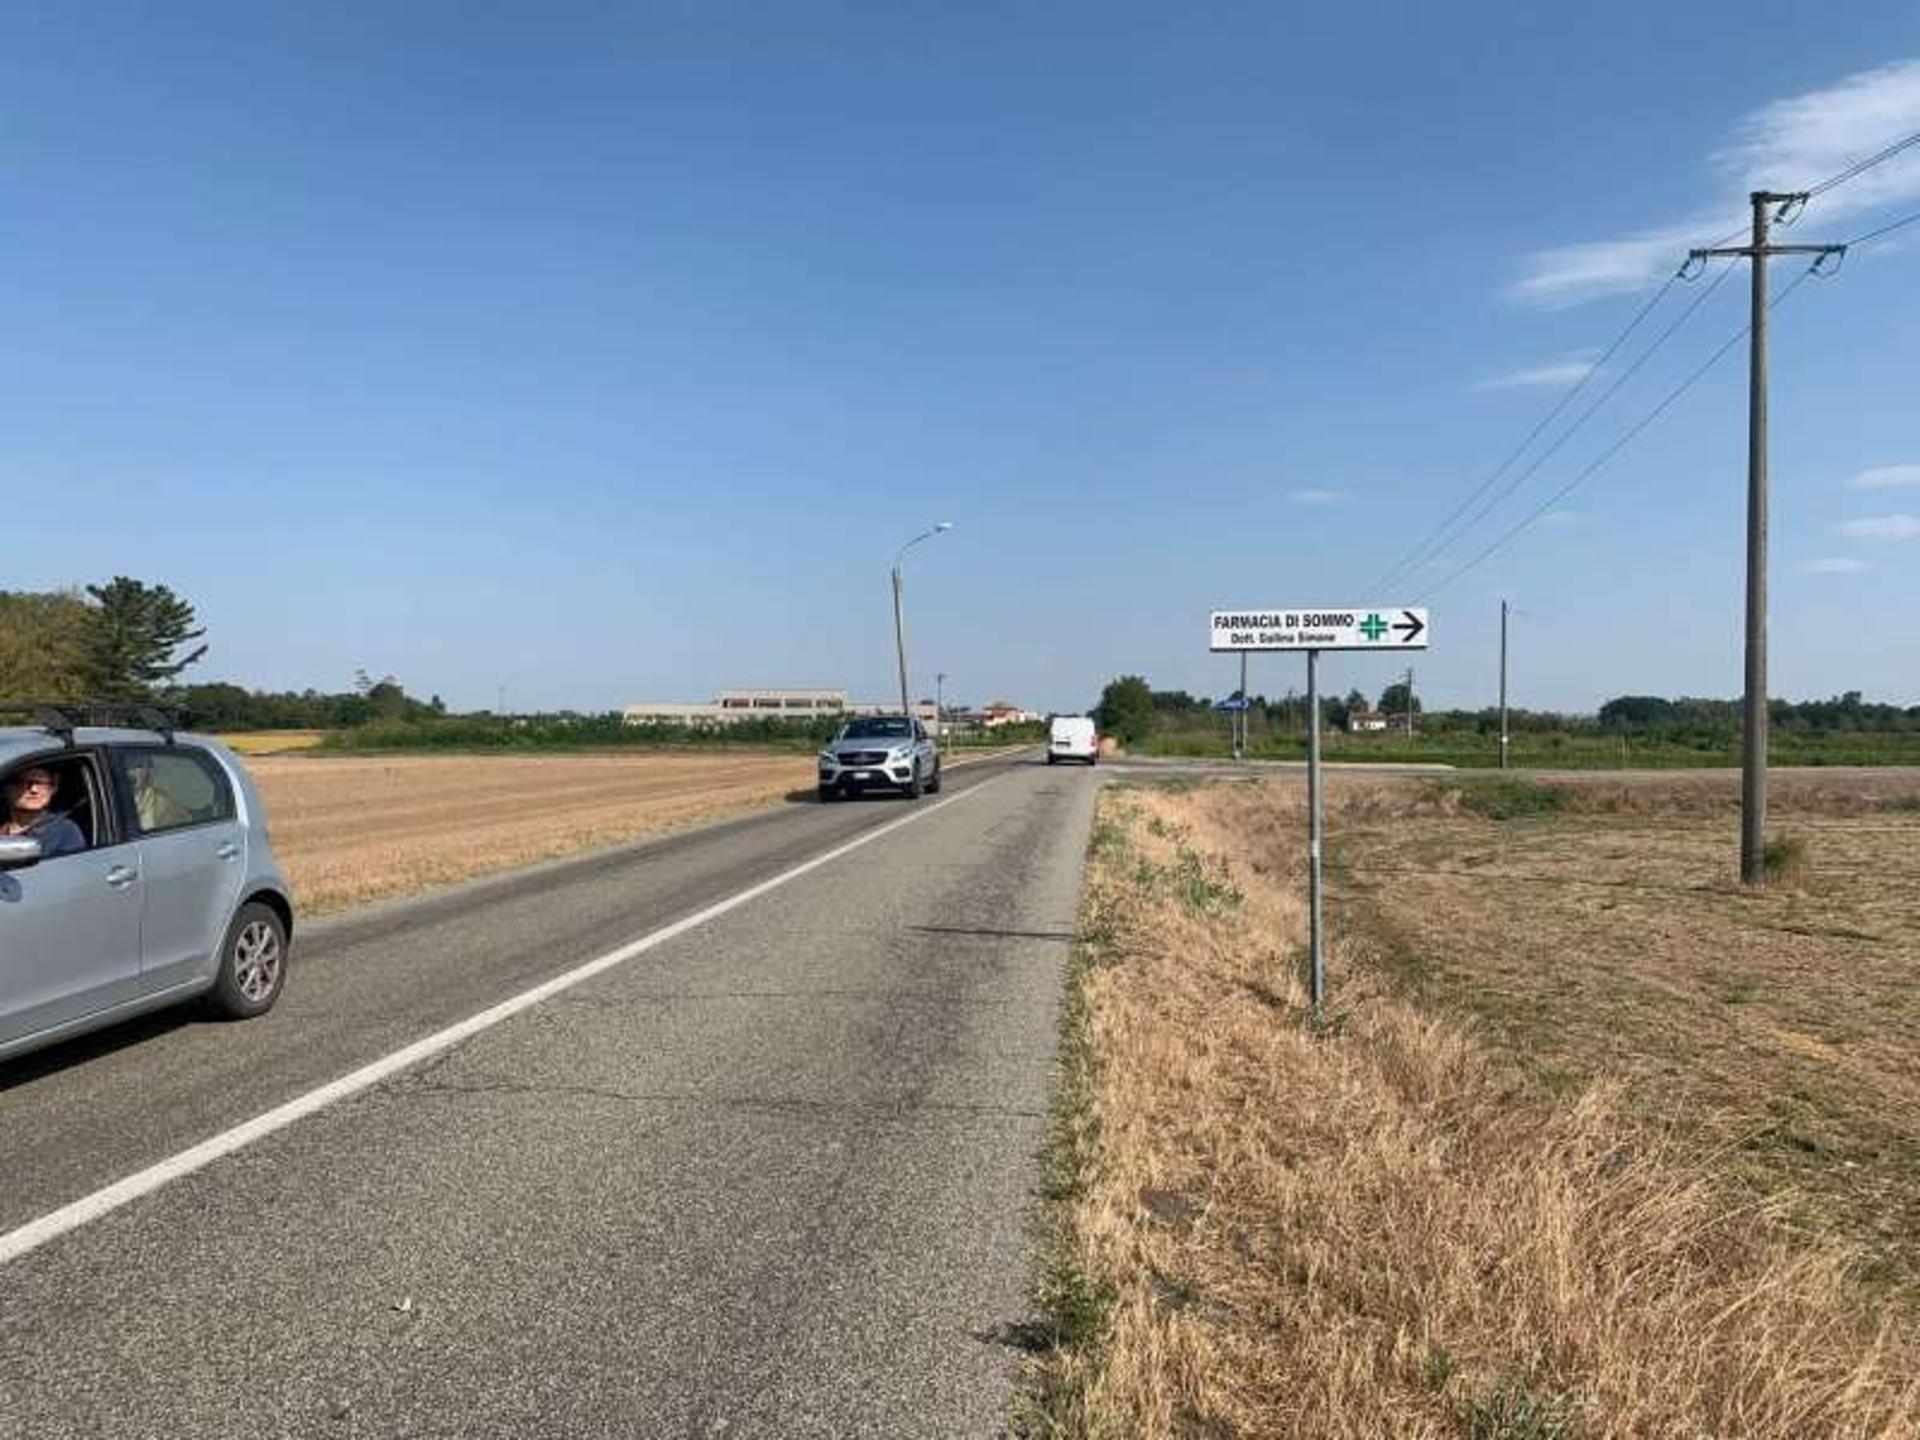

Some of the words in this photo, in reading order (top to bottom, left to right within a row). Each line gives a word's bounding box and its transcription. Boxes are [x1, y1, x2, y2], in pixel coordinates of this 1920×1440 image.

[1214, 614, 1281, 629] FARMACIA
[1286, 614, 1299, 628] DI
[1303, 613, 1354, 627] SOMMO
[1298, 631, 1335, 642] Simone
